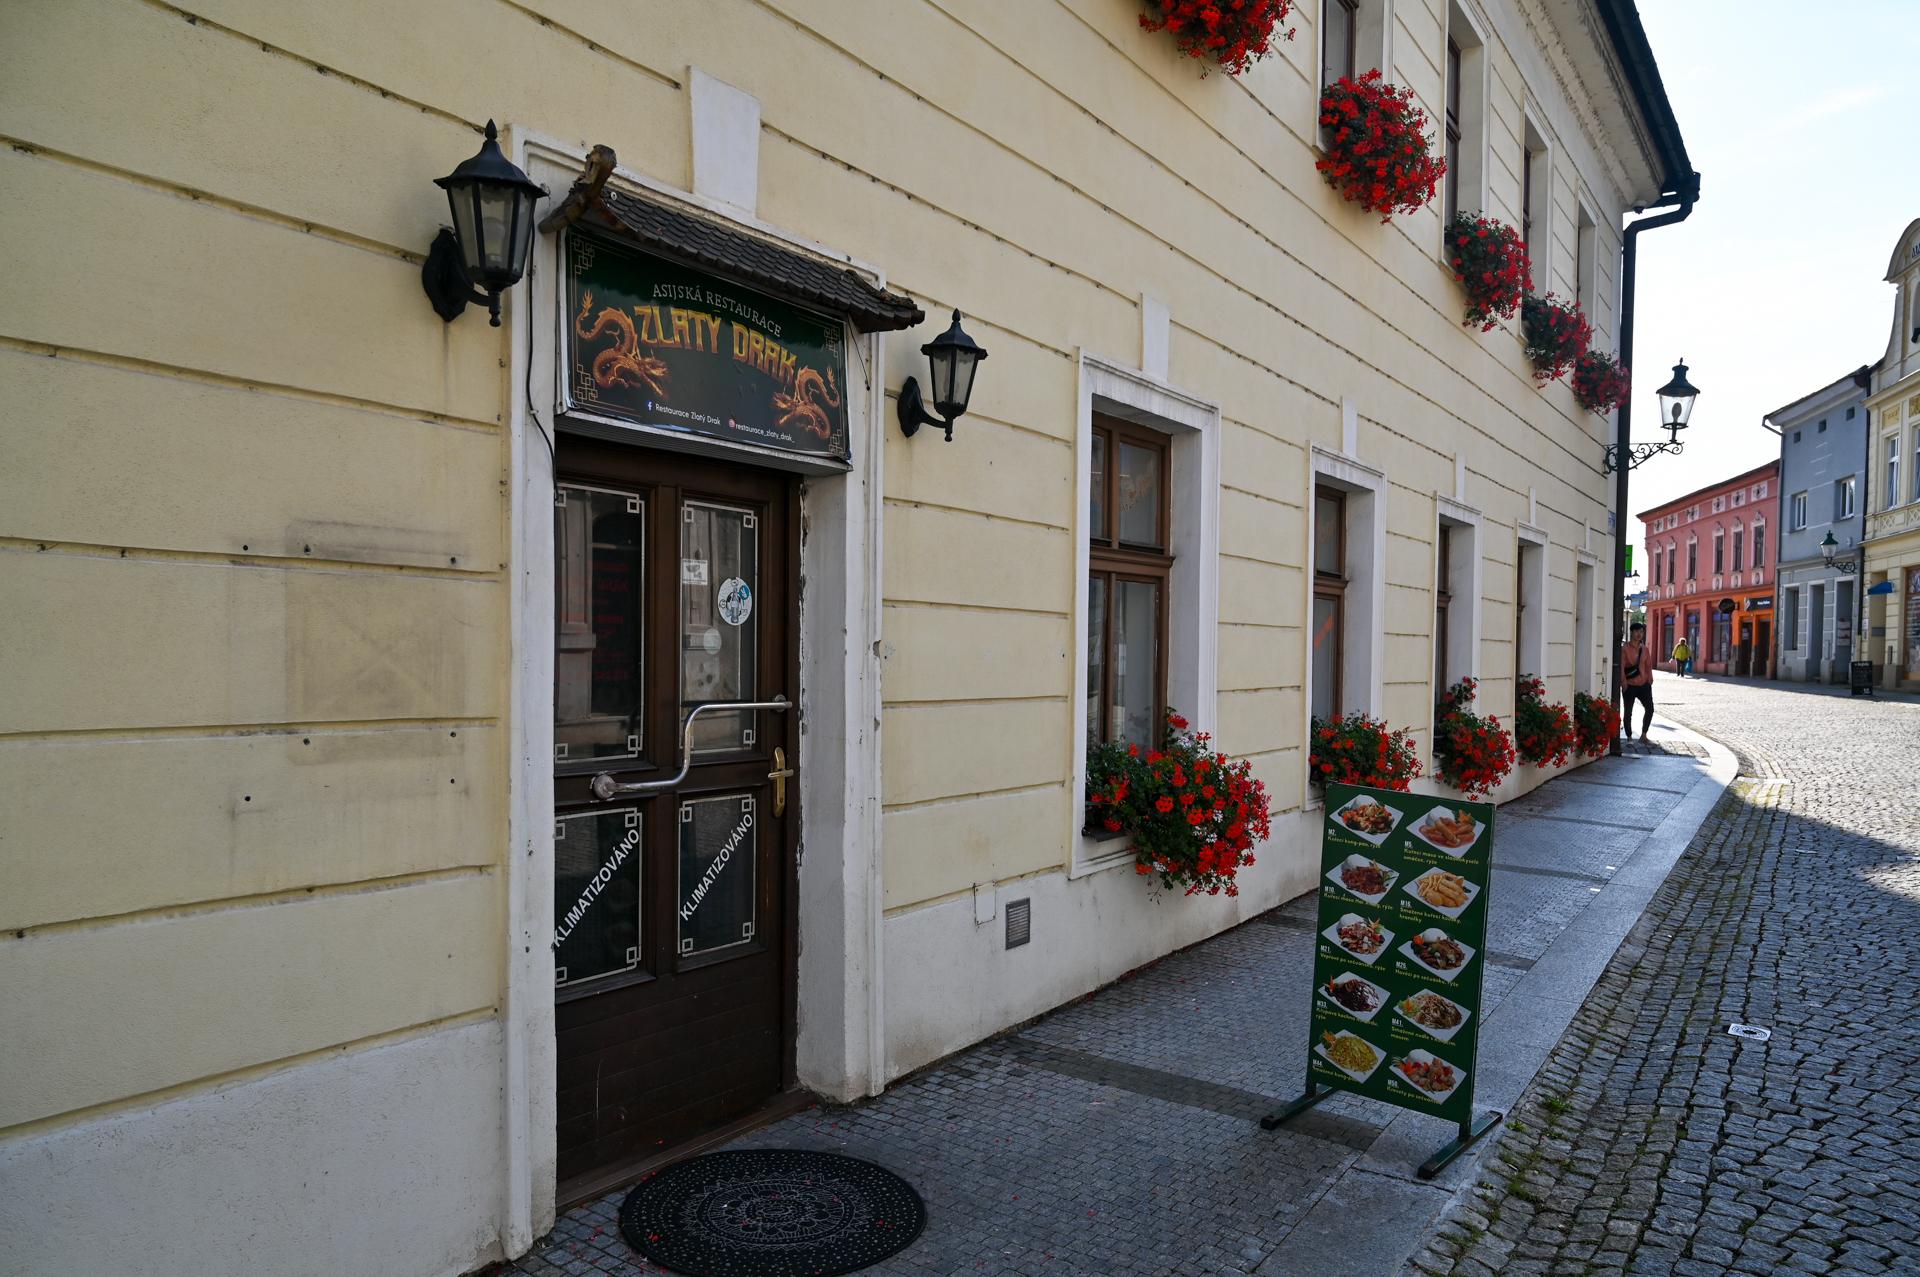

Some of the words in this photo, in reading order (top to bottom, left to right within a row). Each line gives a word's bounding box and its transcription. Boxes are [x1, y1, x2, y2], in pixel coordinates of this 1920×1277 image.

[634, 305, 722, 355] ZLATÝ
[731, 320, 798, 385] DRAK
[653, 283, 703, 302] ASIJSKÁ
[706, 291, 782, 338] RESTAURACE
[655, 403, 690, 418] Restaurace
[690, 411, 706, 423] Zlatý
[706, 415, 721, 426] Drak
[554, 828, 640, 949] KLIMATIZOVÁNO
[680, 813, 754, 922] KLIMATIZOVÁNO
